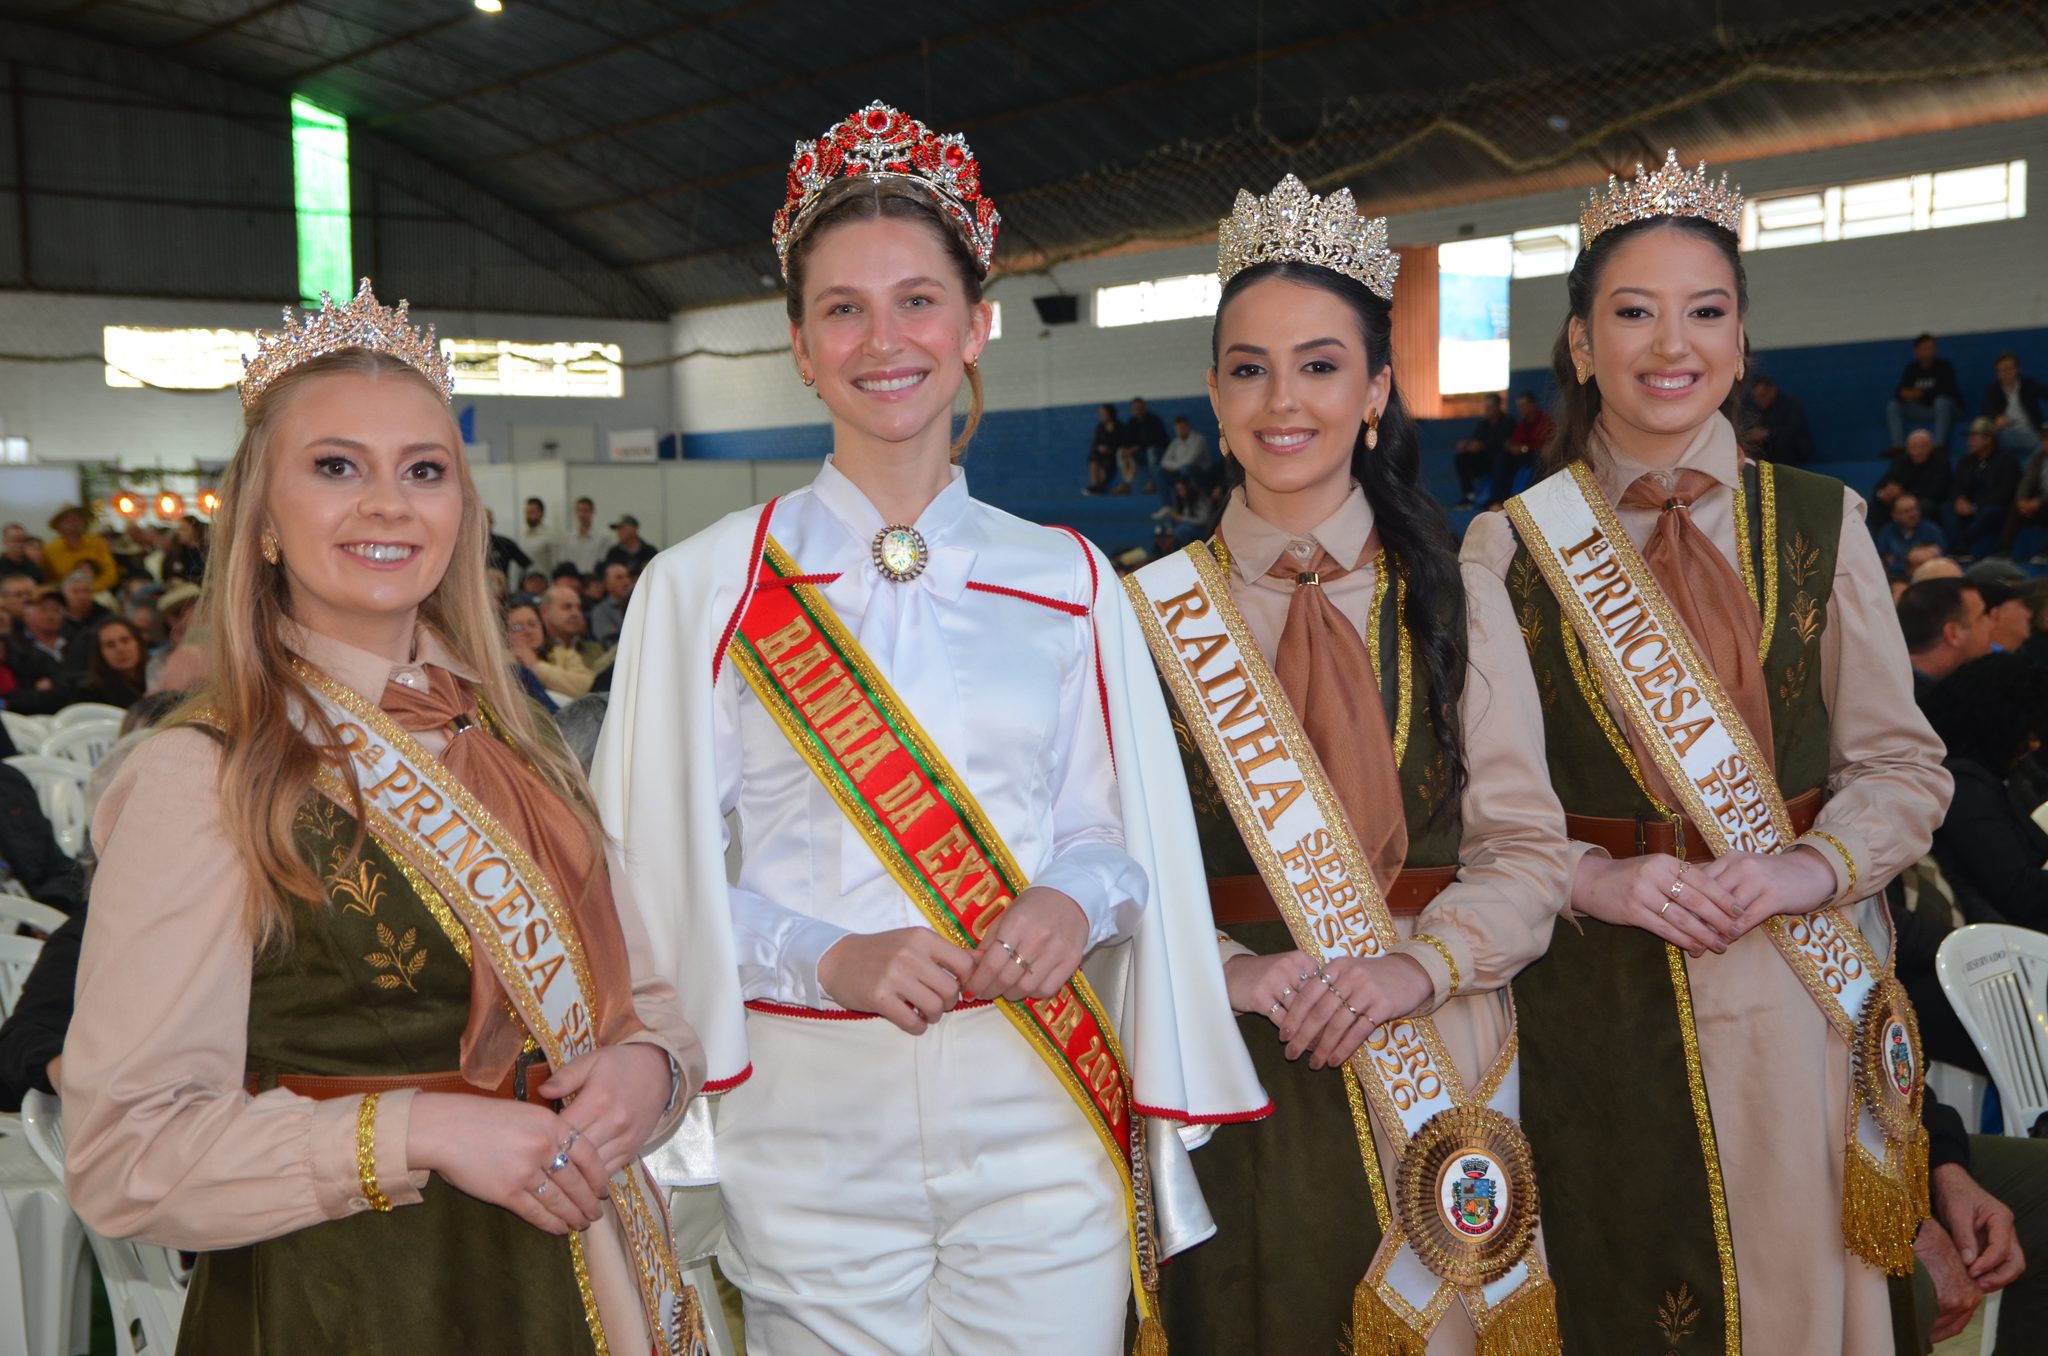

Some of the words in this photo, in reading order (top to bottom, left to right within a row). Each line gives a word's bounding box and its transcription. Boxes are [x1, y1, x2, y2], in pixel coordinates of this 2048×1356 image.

[1154, 581, 1306, 832] RAINHA
[1573, 553, 1715, 759] PRINCESA
[362, 760, 565, 1004] PRINCESA
[755, 615, 899, 783] RAINHA
[874, 770, 937, 835] DA
[1076, 1035, 1124, 1127] 2026
[1277, 840, 1352, 957] FES
[1367, 1023, 1418, 1111] 026
[1302, 828, 1379, 957] SEBER
[1387, 1018, 1441, 1100] GRO
[1785, 917, 1847, 994] 026
[1804, 911, 1862, 980] GRO
